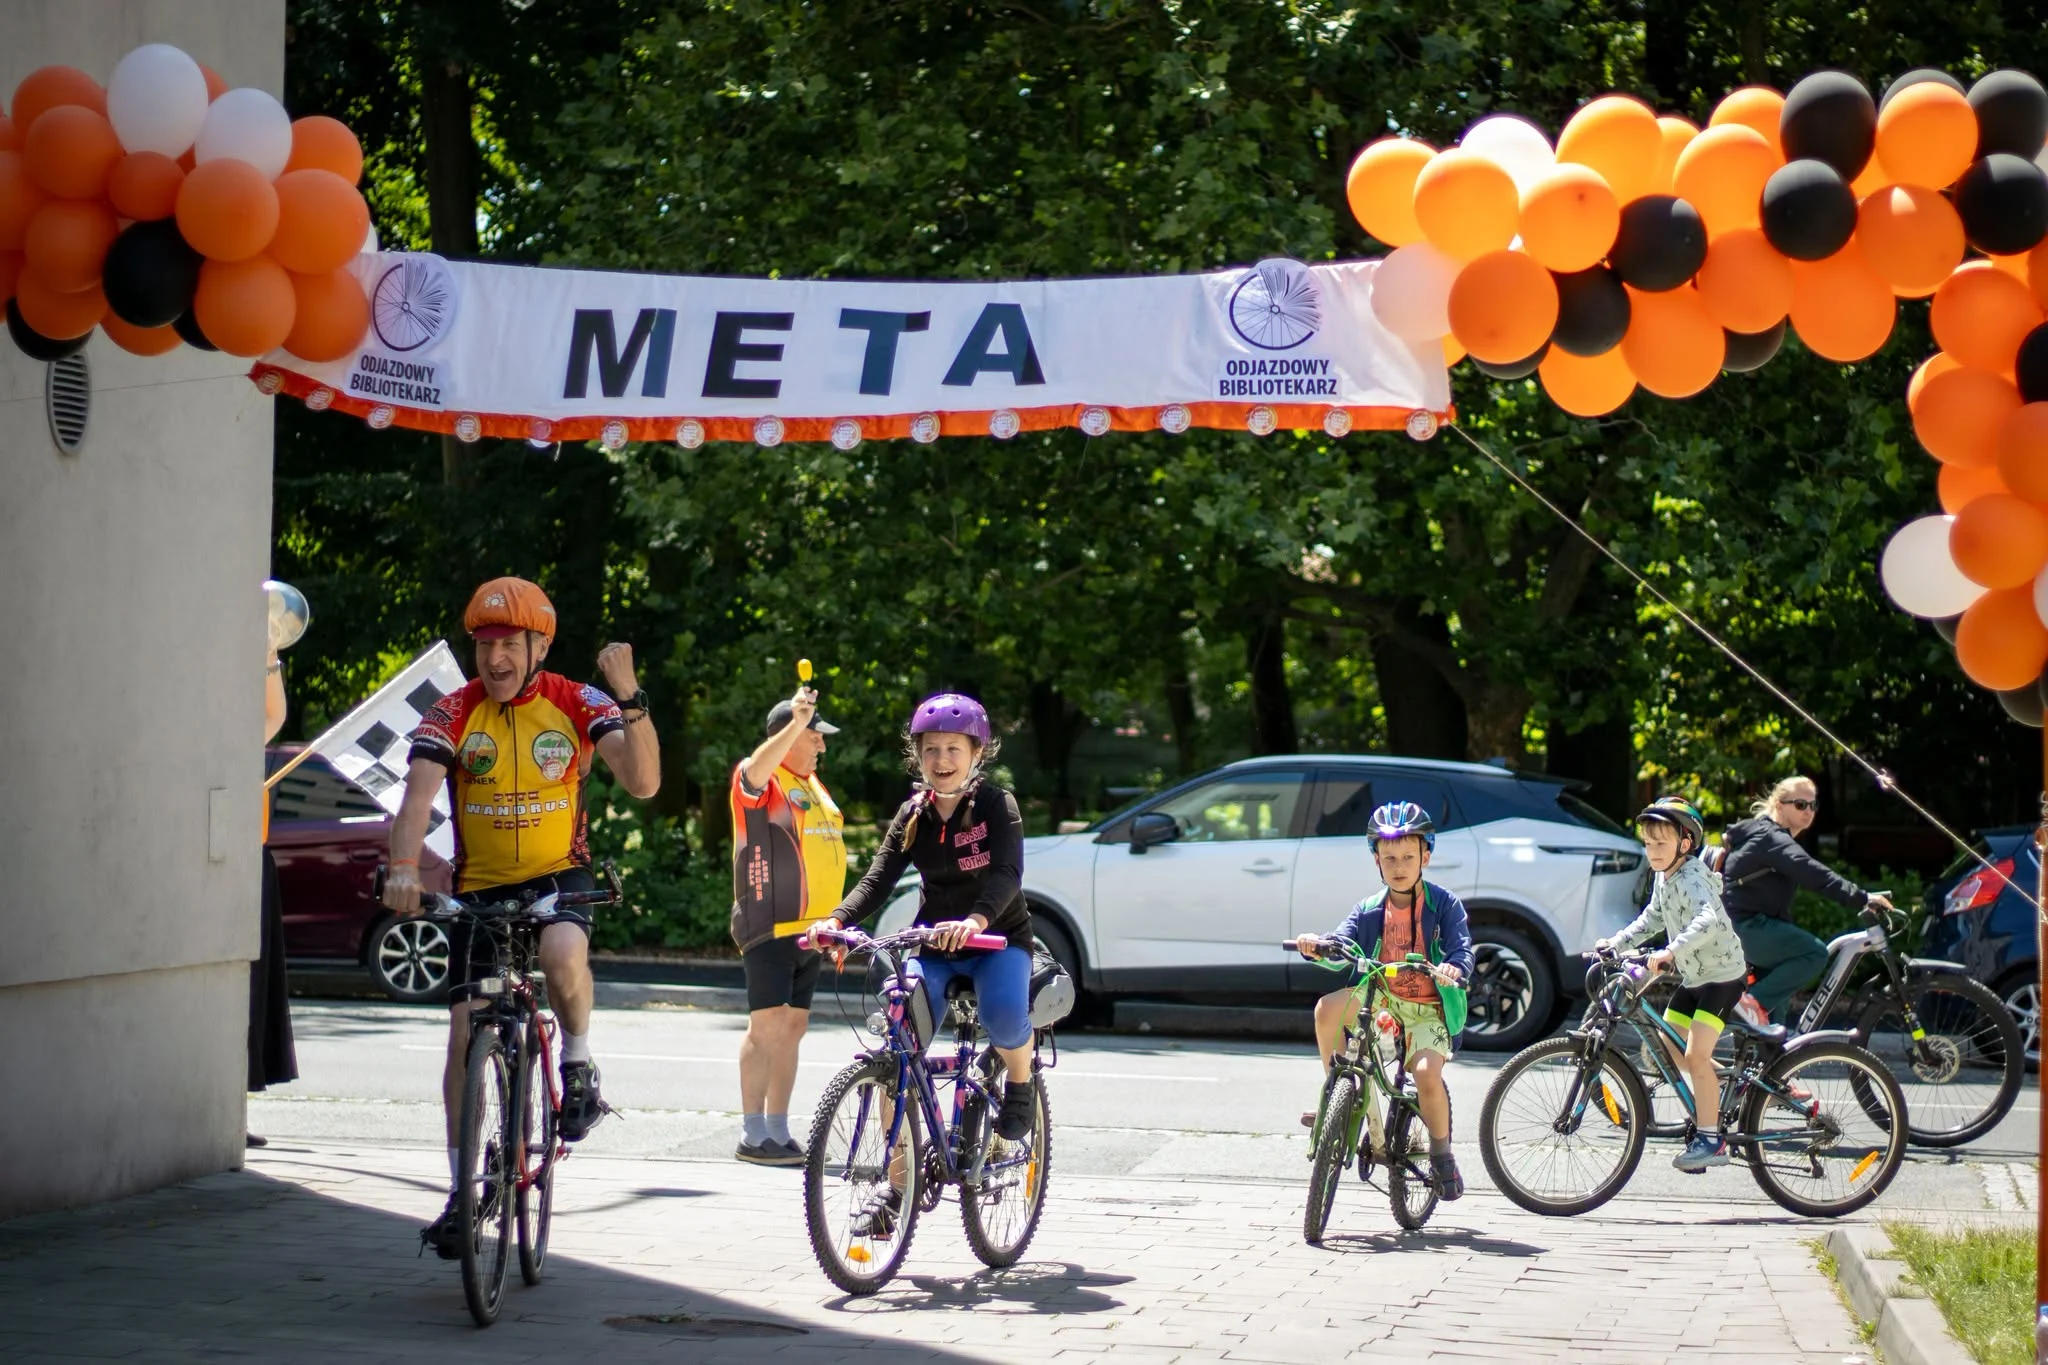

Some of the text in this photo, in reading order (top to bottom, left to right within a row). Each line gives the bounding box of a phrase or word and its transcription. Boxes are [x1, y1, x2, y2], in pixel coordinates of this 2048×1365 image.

[563, 303, 1046, 399] META
[361, 354, 435, 384] ODJAZDOWY
[1226, 359, 1330, 376] ODJAZDOWY
[350, 373, 441, 405] BIBLIOTEKARZ
[1219, 379, 1338, 396] BIBLIOTEKARZ
[466, 799, 568, 816] WANDRUS
[971, 842, 980, 855] IS
[1799, 976, 1838, 1034] CUBE
